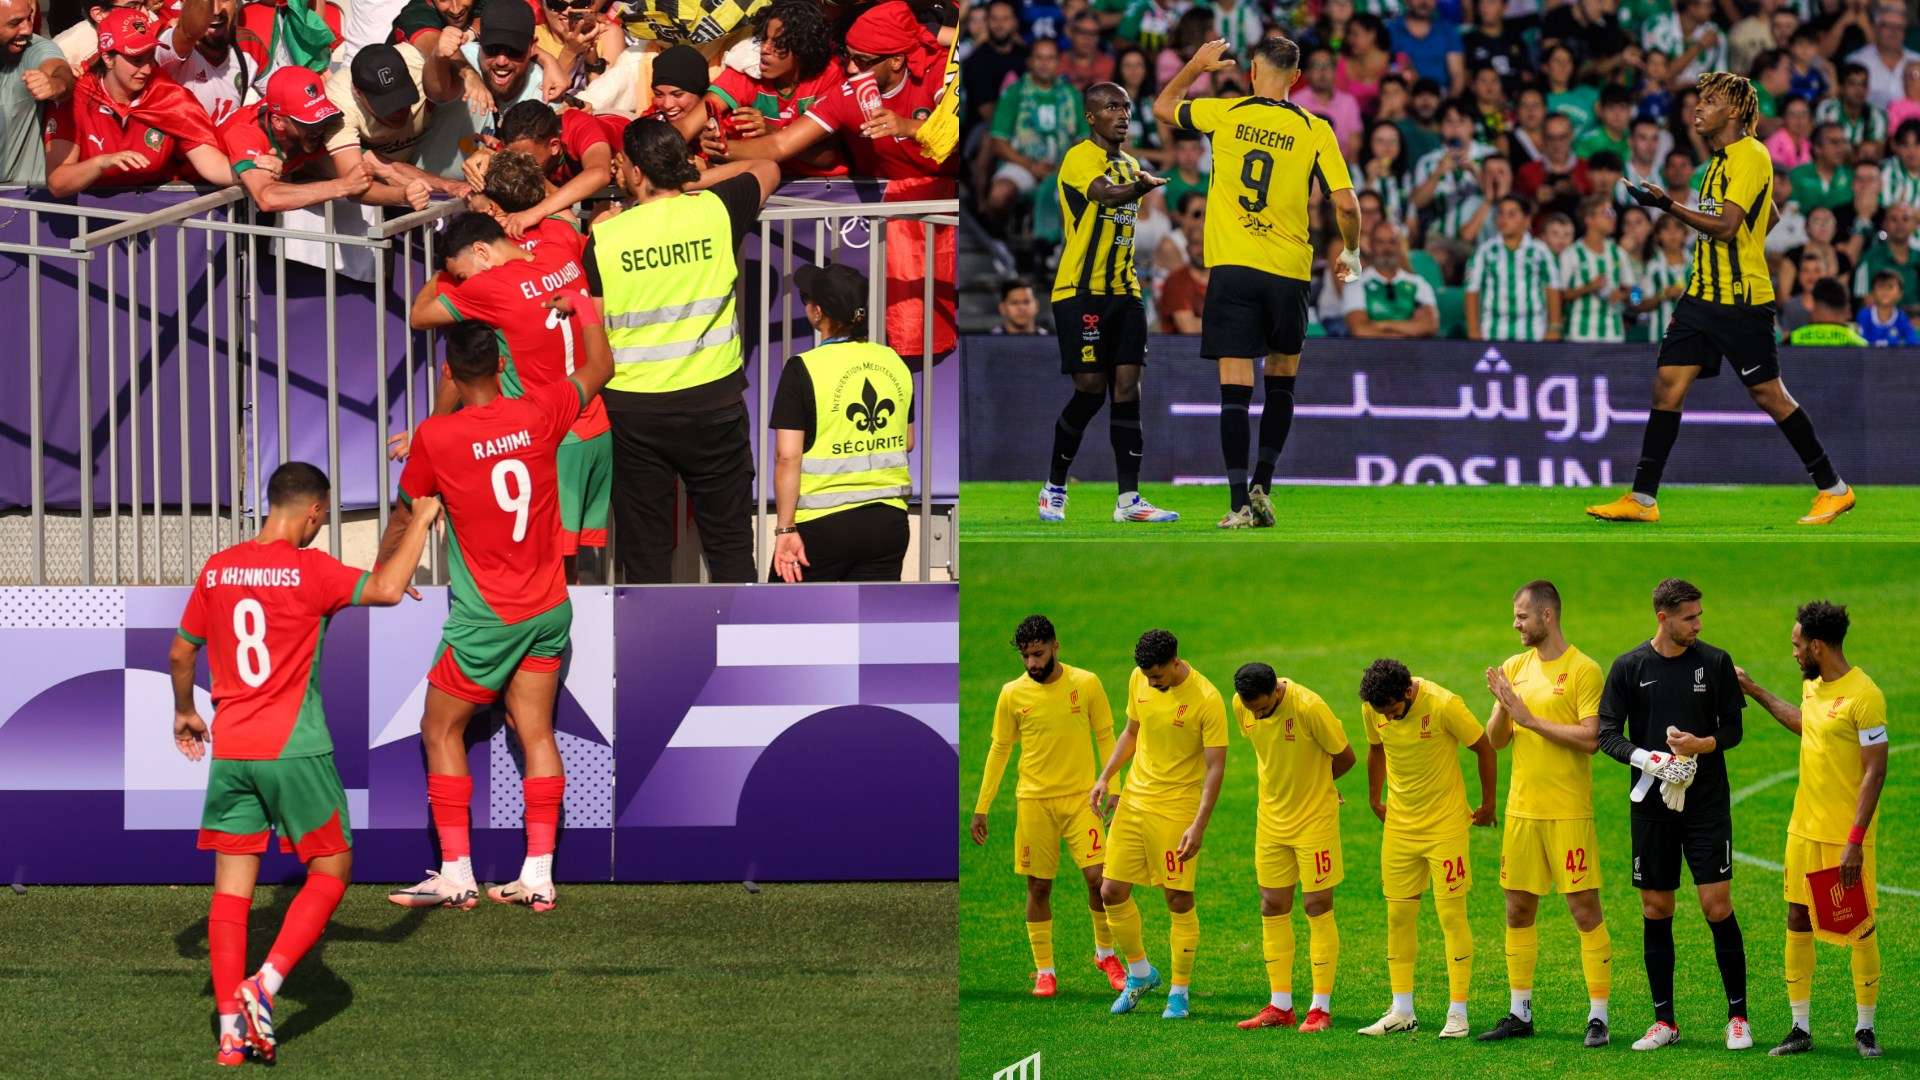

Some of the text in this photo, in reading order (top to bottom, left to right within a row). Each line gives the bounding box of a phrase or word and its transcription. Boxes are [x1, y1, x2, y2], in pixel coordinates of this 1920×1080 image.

[1235, 124, 1295, 151] BENZEMA
[1239, 149, 1274, 213] 9
[621, 238, 712, 272] SECURITE
[520, 261, 581, 300] EL OUAHDI
[472, 429, 531, 460] RAHIMI
[491, 458, 532, 542] 9
[233, 598, 271, 688] 8
[1088, 828, 1101, 850] 2
[1315, 850, 1331, 875] 15
[1443, 856, 1465, 883] 24
[1566, 848, 1587, 872] 42
